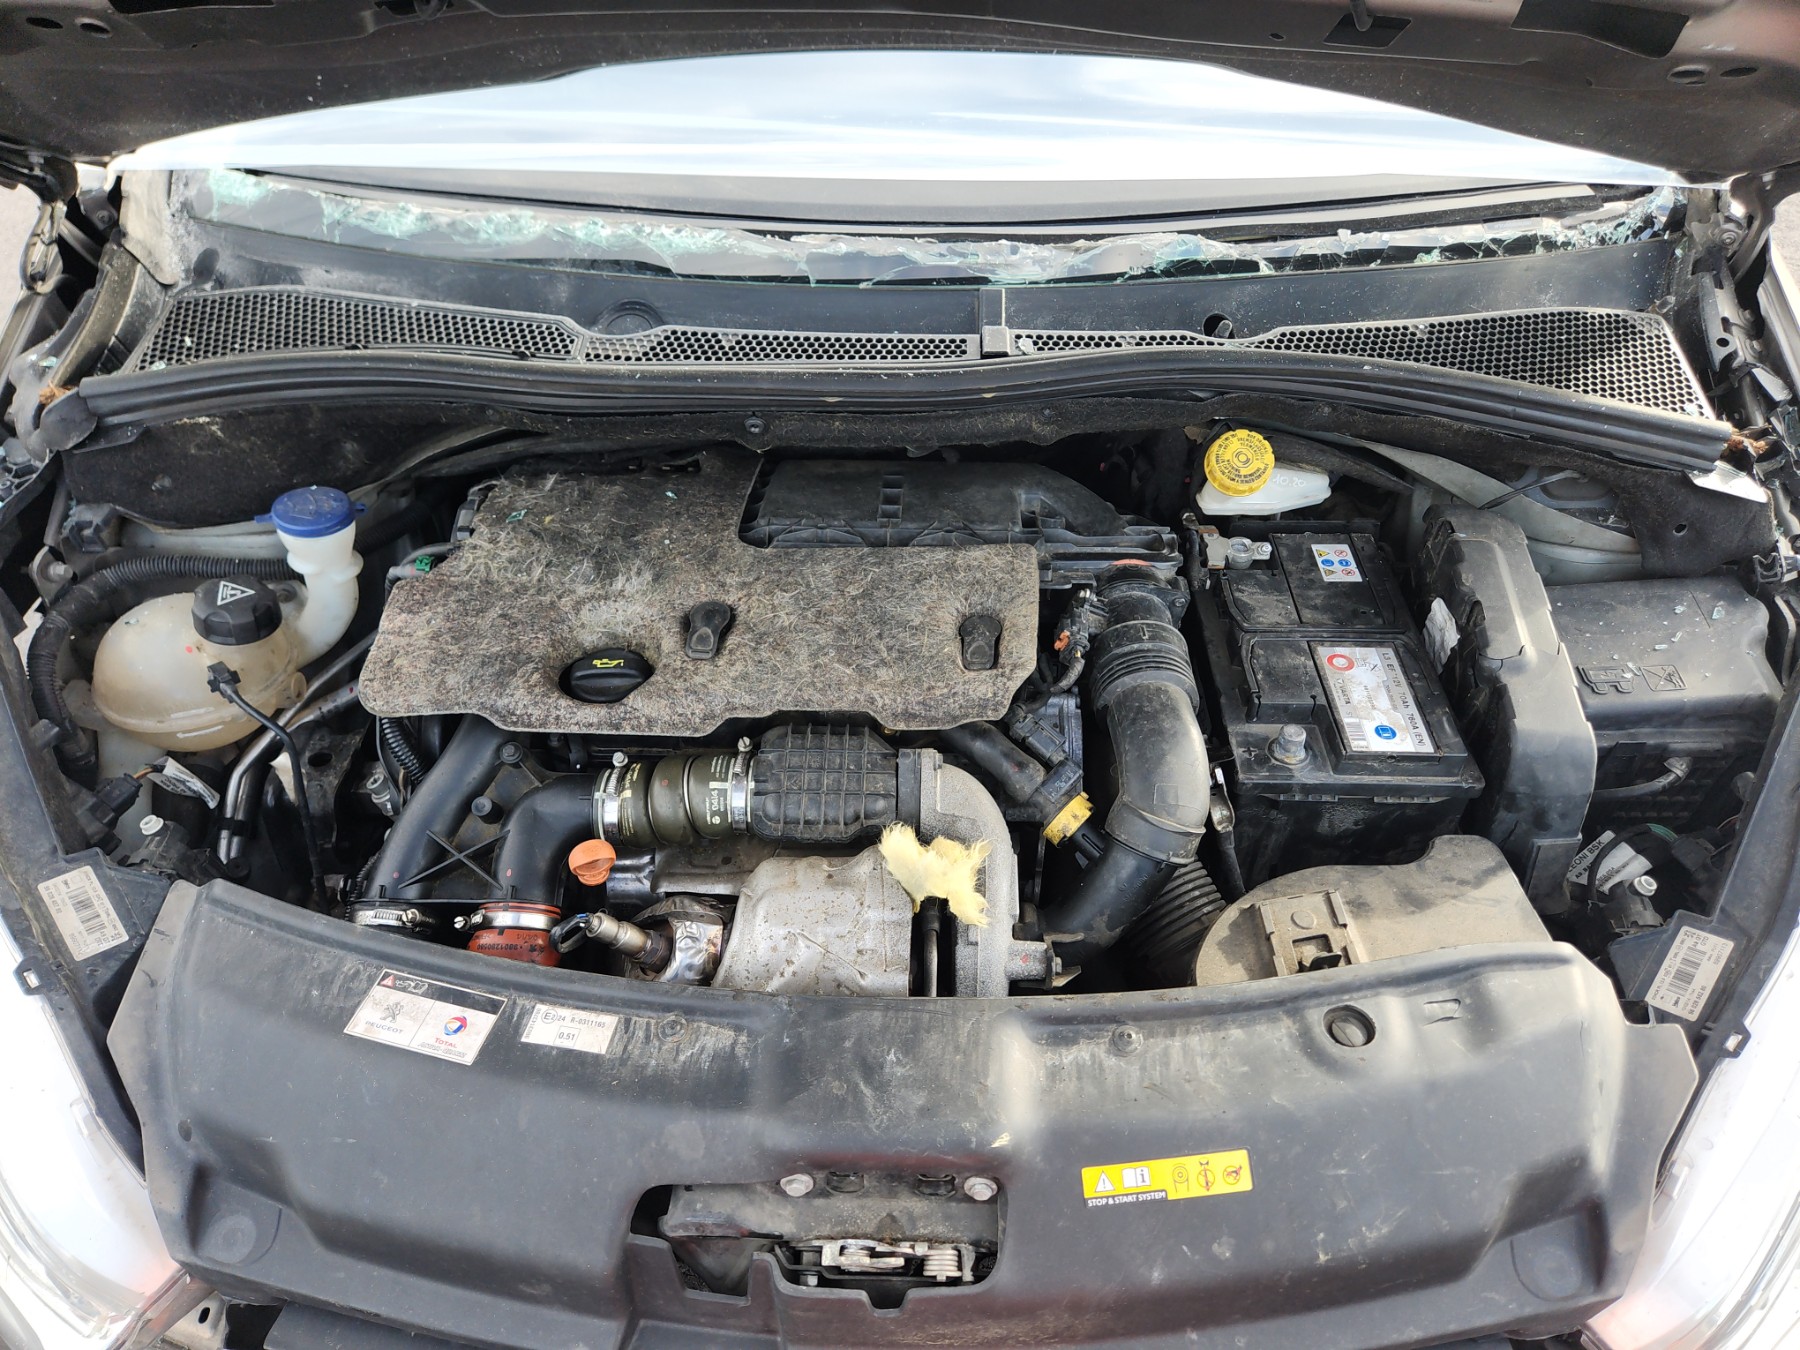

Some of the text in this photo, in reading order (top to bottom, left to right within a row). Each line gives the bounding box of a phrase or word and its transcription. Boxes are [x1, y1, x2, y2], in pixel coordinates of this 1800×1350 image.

[1587, 839, 1605, 854] BSK
[365, 1020, 404, 1034] PEUGEOT
[435, 1037, 458, 1049] TOTAL
[558, 1032, 576, 1041] 0.51
[1087, 1191, 1166, 1207] STOP & START SYSTEM
